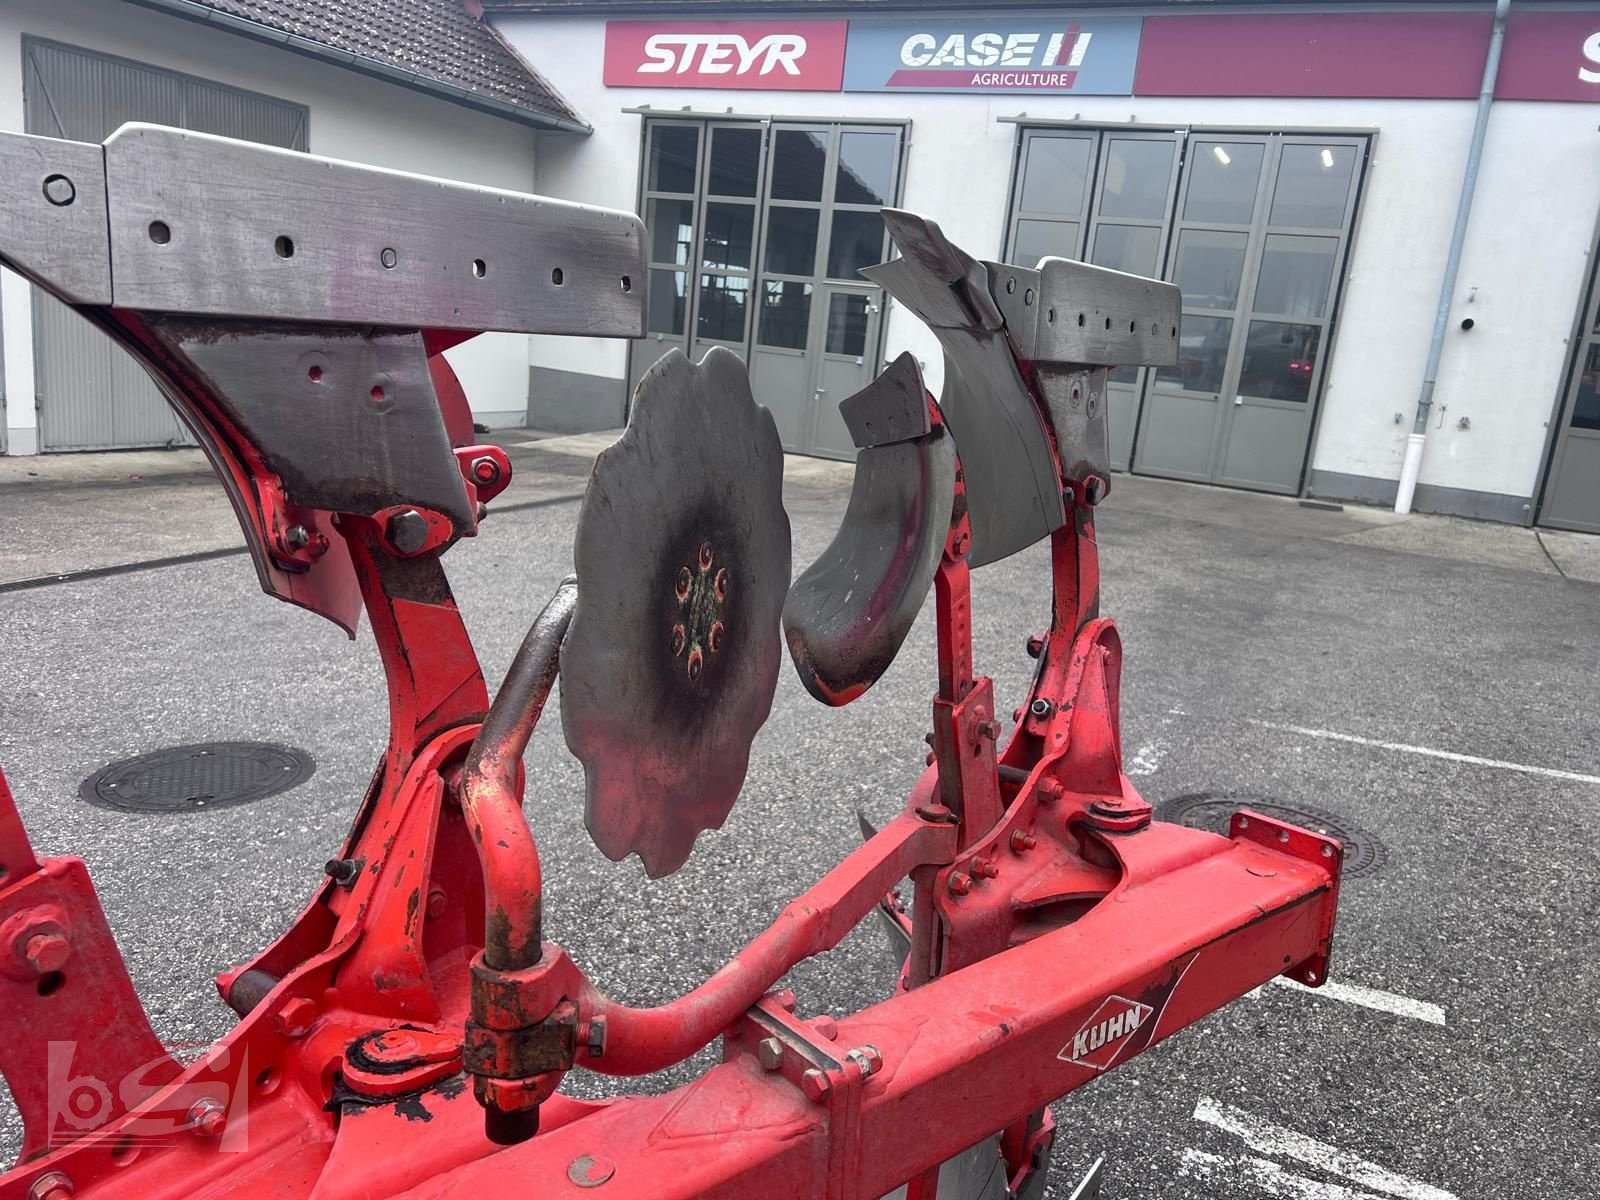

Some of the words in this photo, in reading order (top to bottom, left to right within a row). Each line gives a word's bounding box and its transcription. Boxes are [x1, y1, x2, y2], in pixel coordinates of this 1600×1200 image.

[637, 33, 807, 76] STEYR
[900, 32, 1040, 67] CASE
[971, 72, 1068, 87] AGRICULTURE
[1071, 1004, 1141, 1060] KUHN
